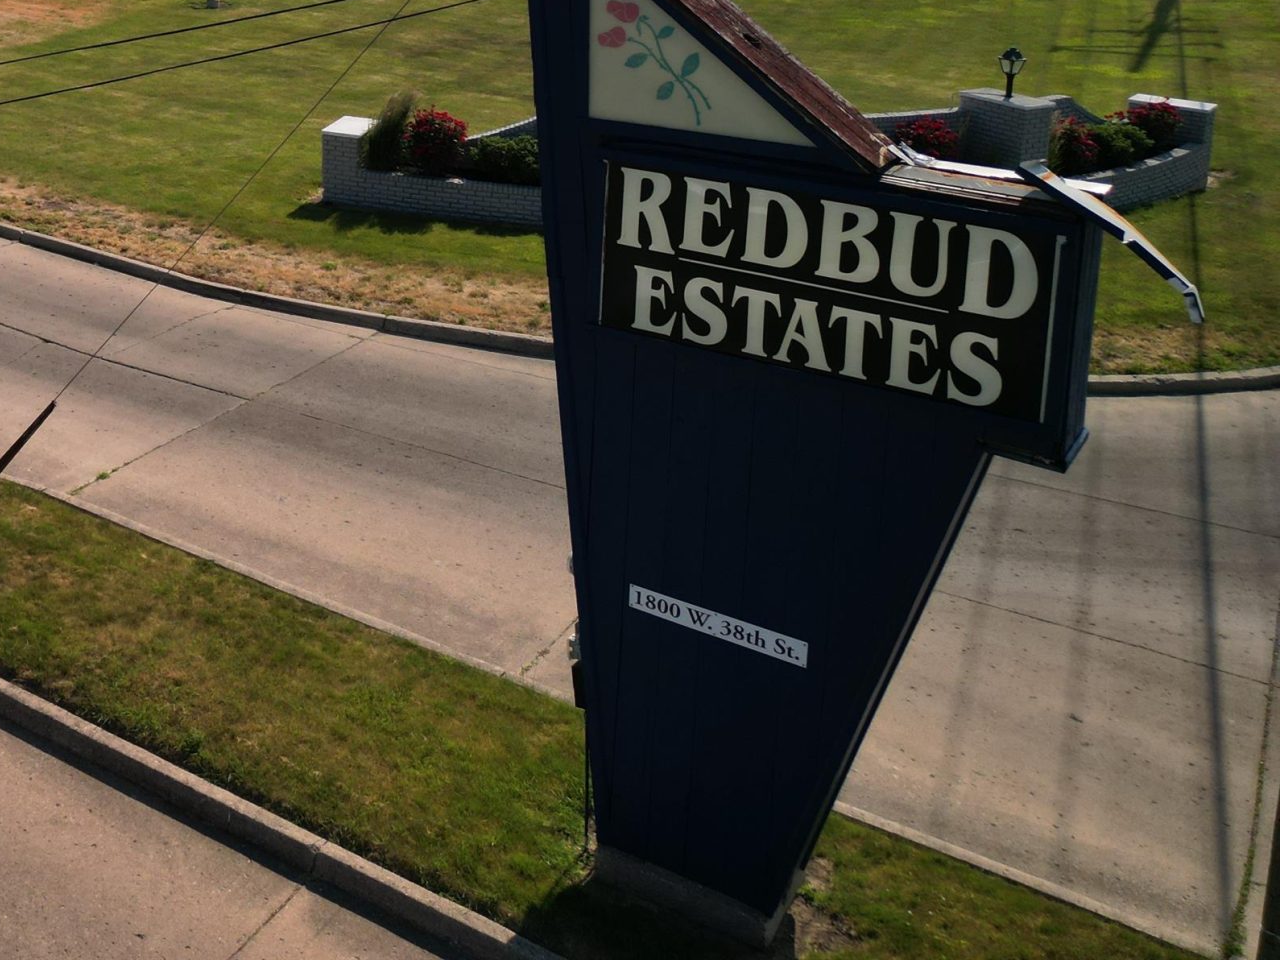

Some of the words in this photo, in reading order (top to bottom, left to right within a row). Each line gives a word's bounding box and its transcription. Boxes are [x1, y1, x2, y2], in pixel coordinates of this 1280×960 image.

[617, 166, 1039, 320] REDBUD
[631, 264, 1003, 407] ESTATES
[634, 590, 681, 618] 1800
[686, 606, 713, 630] W.
[719, 620, 767, 649] 38th
[773, 638, 800, 661] St.
